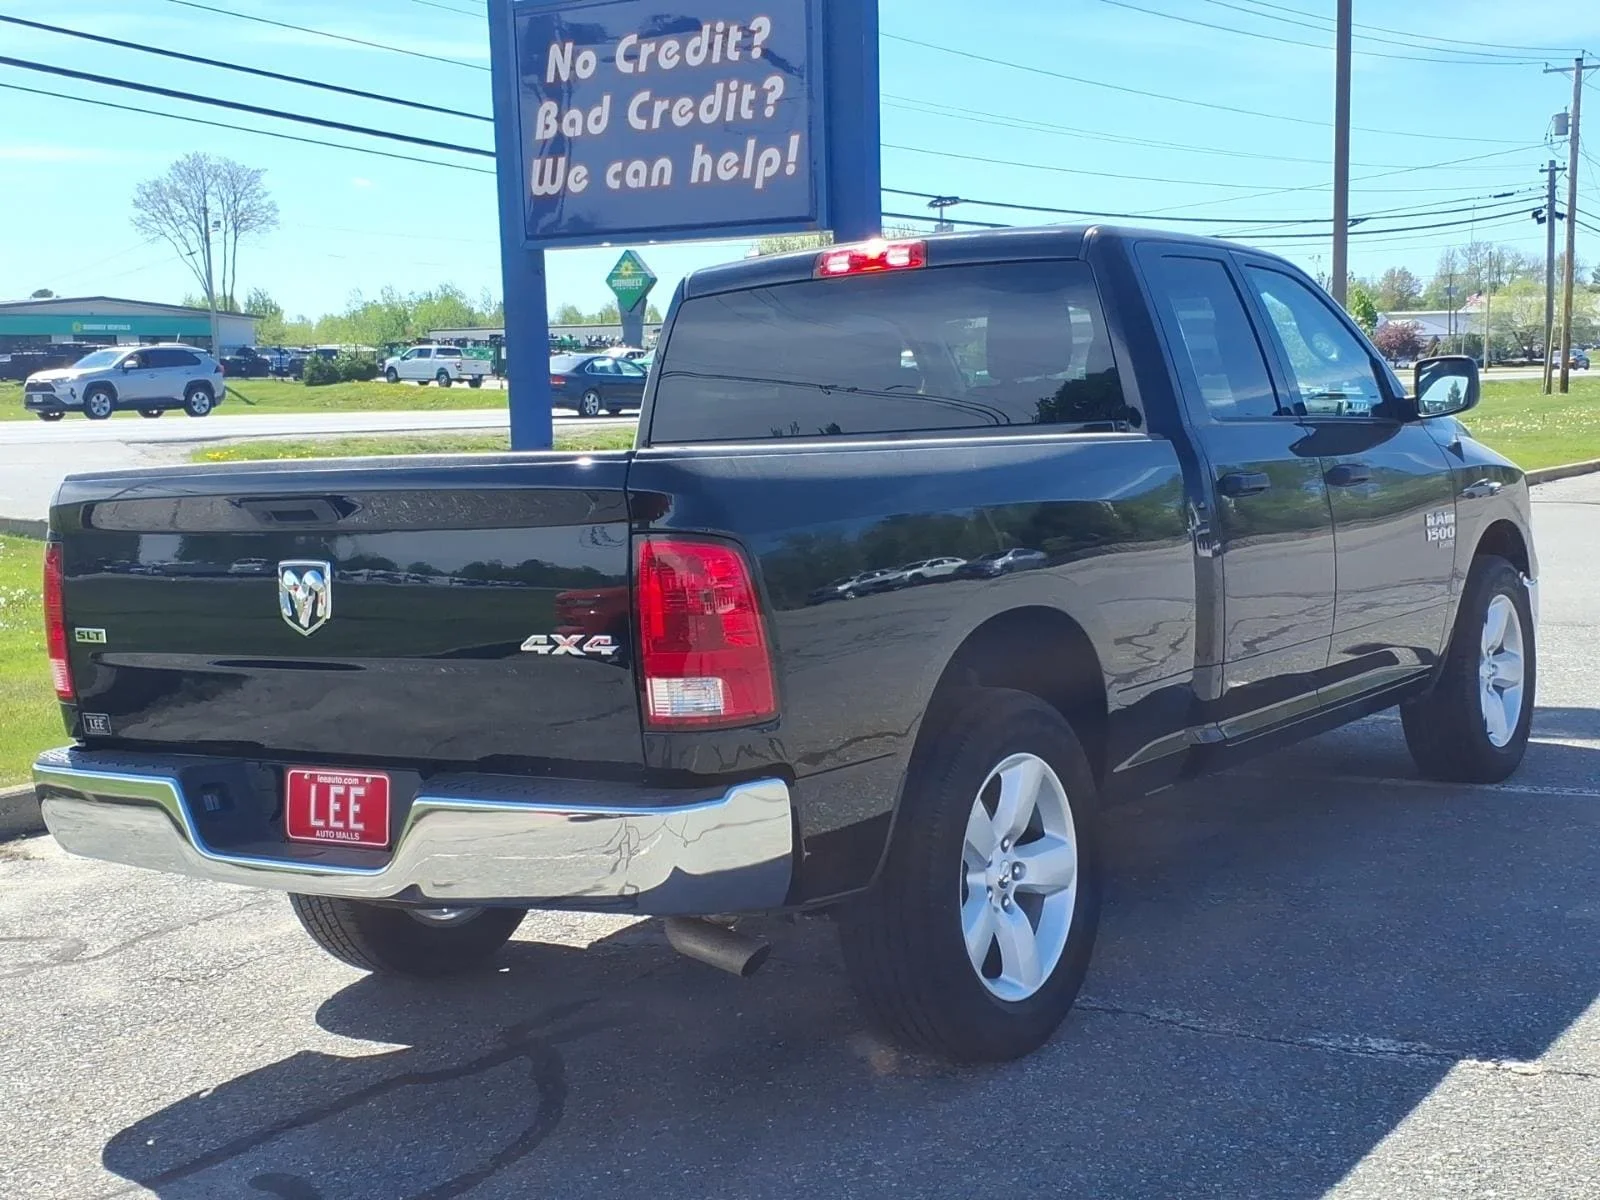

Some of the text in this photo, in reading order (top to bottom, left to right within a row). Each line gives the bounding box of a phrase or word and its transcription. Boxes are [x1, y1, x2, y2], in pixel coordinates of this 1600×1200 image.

[546, 16, 771, 83] No Credit?
[535, 75, 784, 140] Bad Credit?
[531, 134, 800, 196] We can help!
[1427, 526, 1455, 541] 1500
[76, 630, 102, 640] SLT
[89, 719, 105, 730] LEE
[317, 775, 359, 785] leeauto.com
[310, 784, 365, 831] LEE
[315, 830, 360, 841] AUTO MALLS
